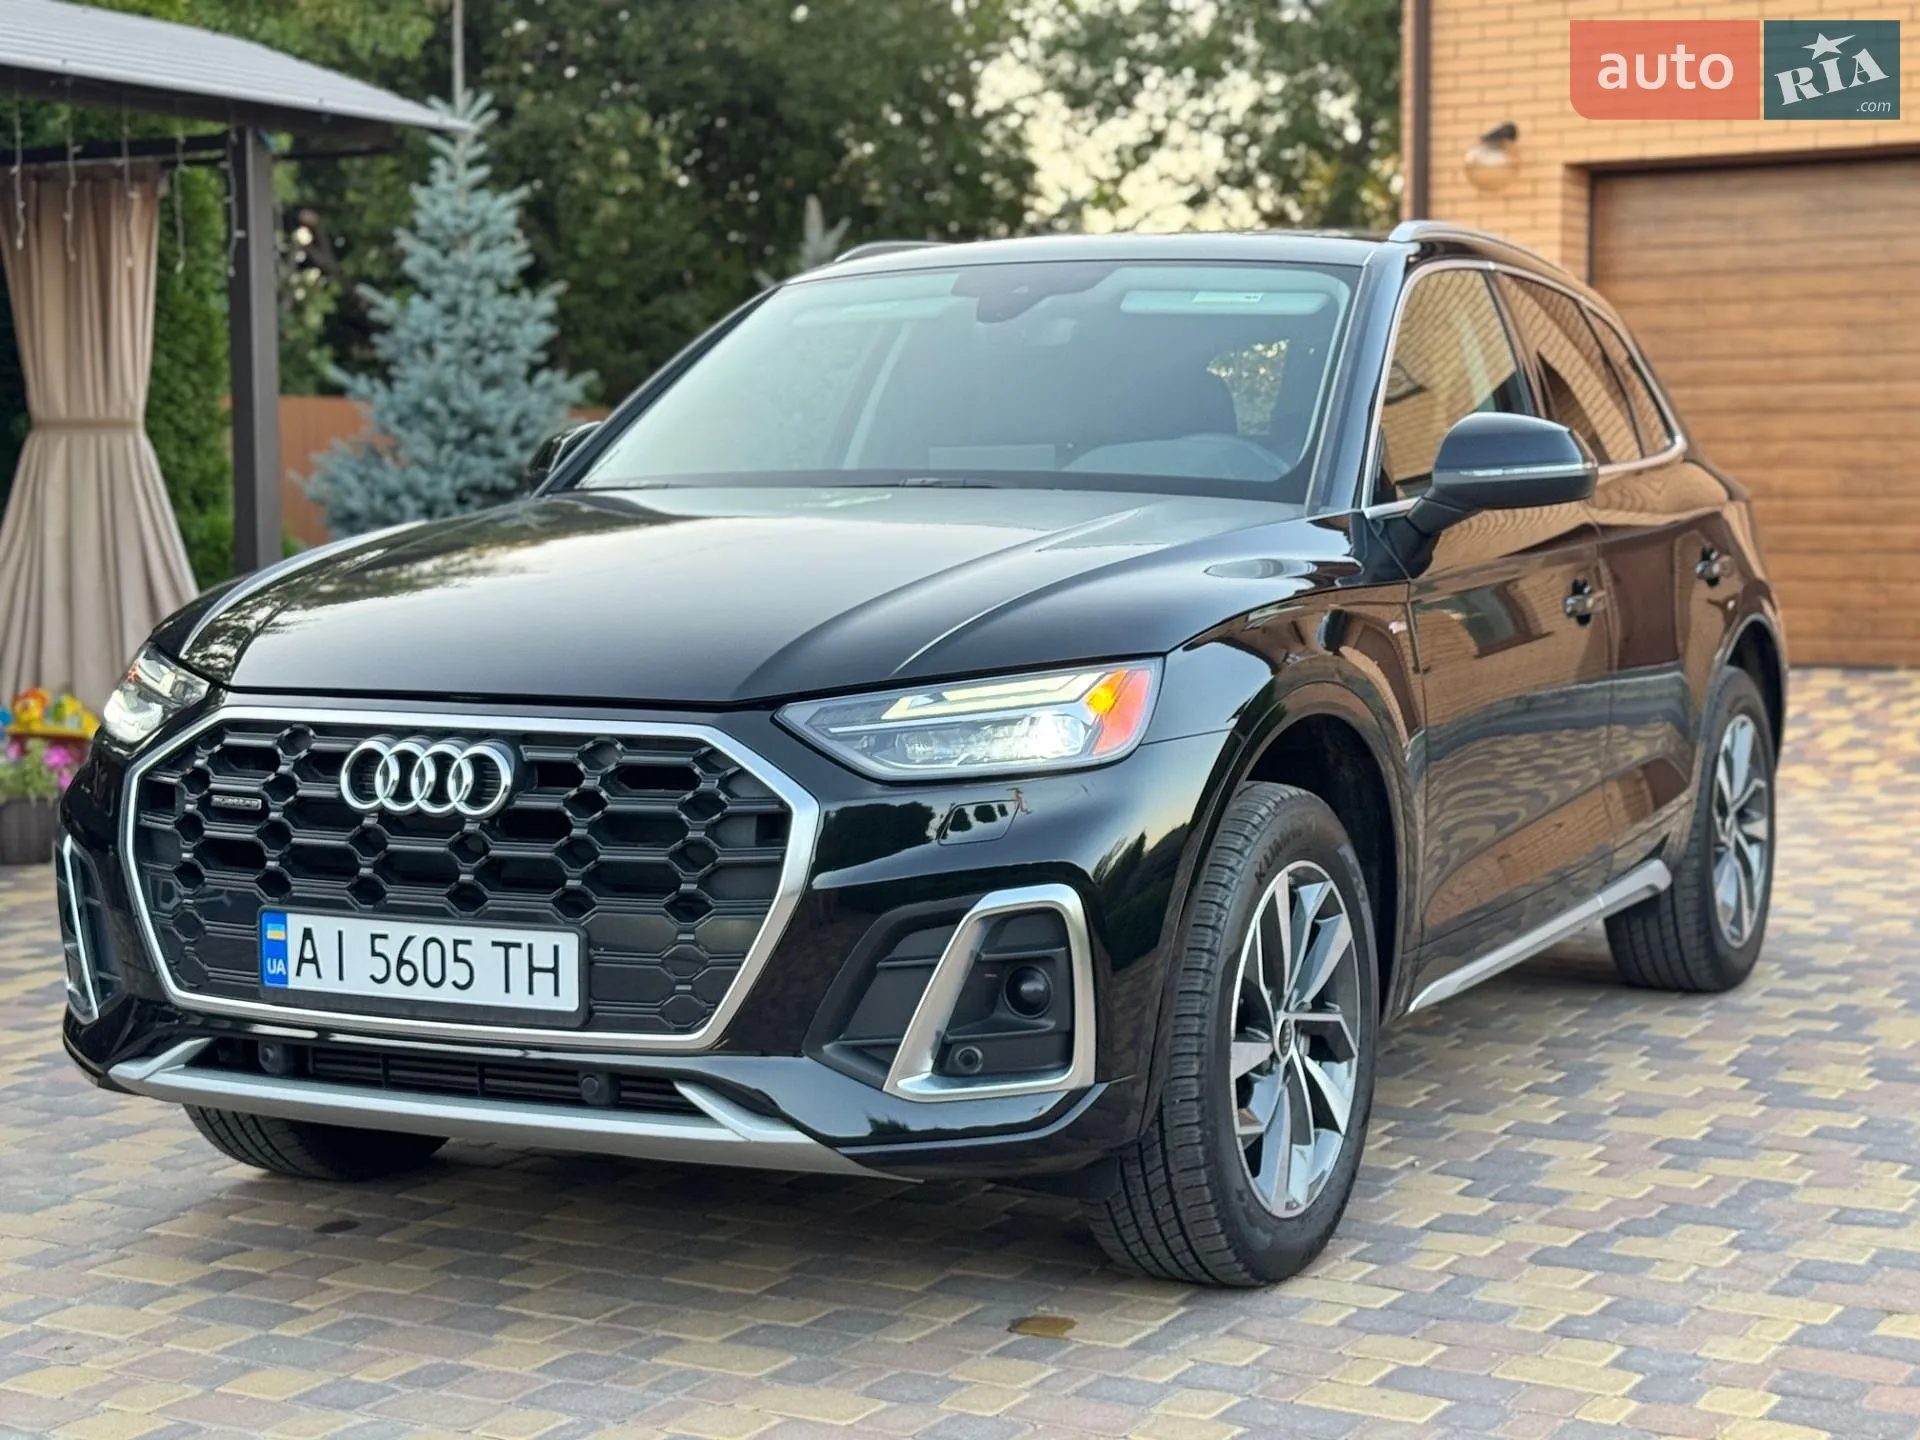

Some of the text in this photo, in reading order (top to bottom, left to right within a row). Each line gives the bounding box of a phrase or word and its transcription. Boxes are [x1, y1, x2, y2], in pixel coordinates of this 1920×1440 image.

[267, 958, 286, 975] UA
[369, 933, 475, 990] 5605
[491, 940, 560, 997] TH
